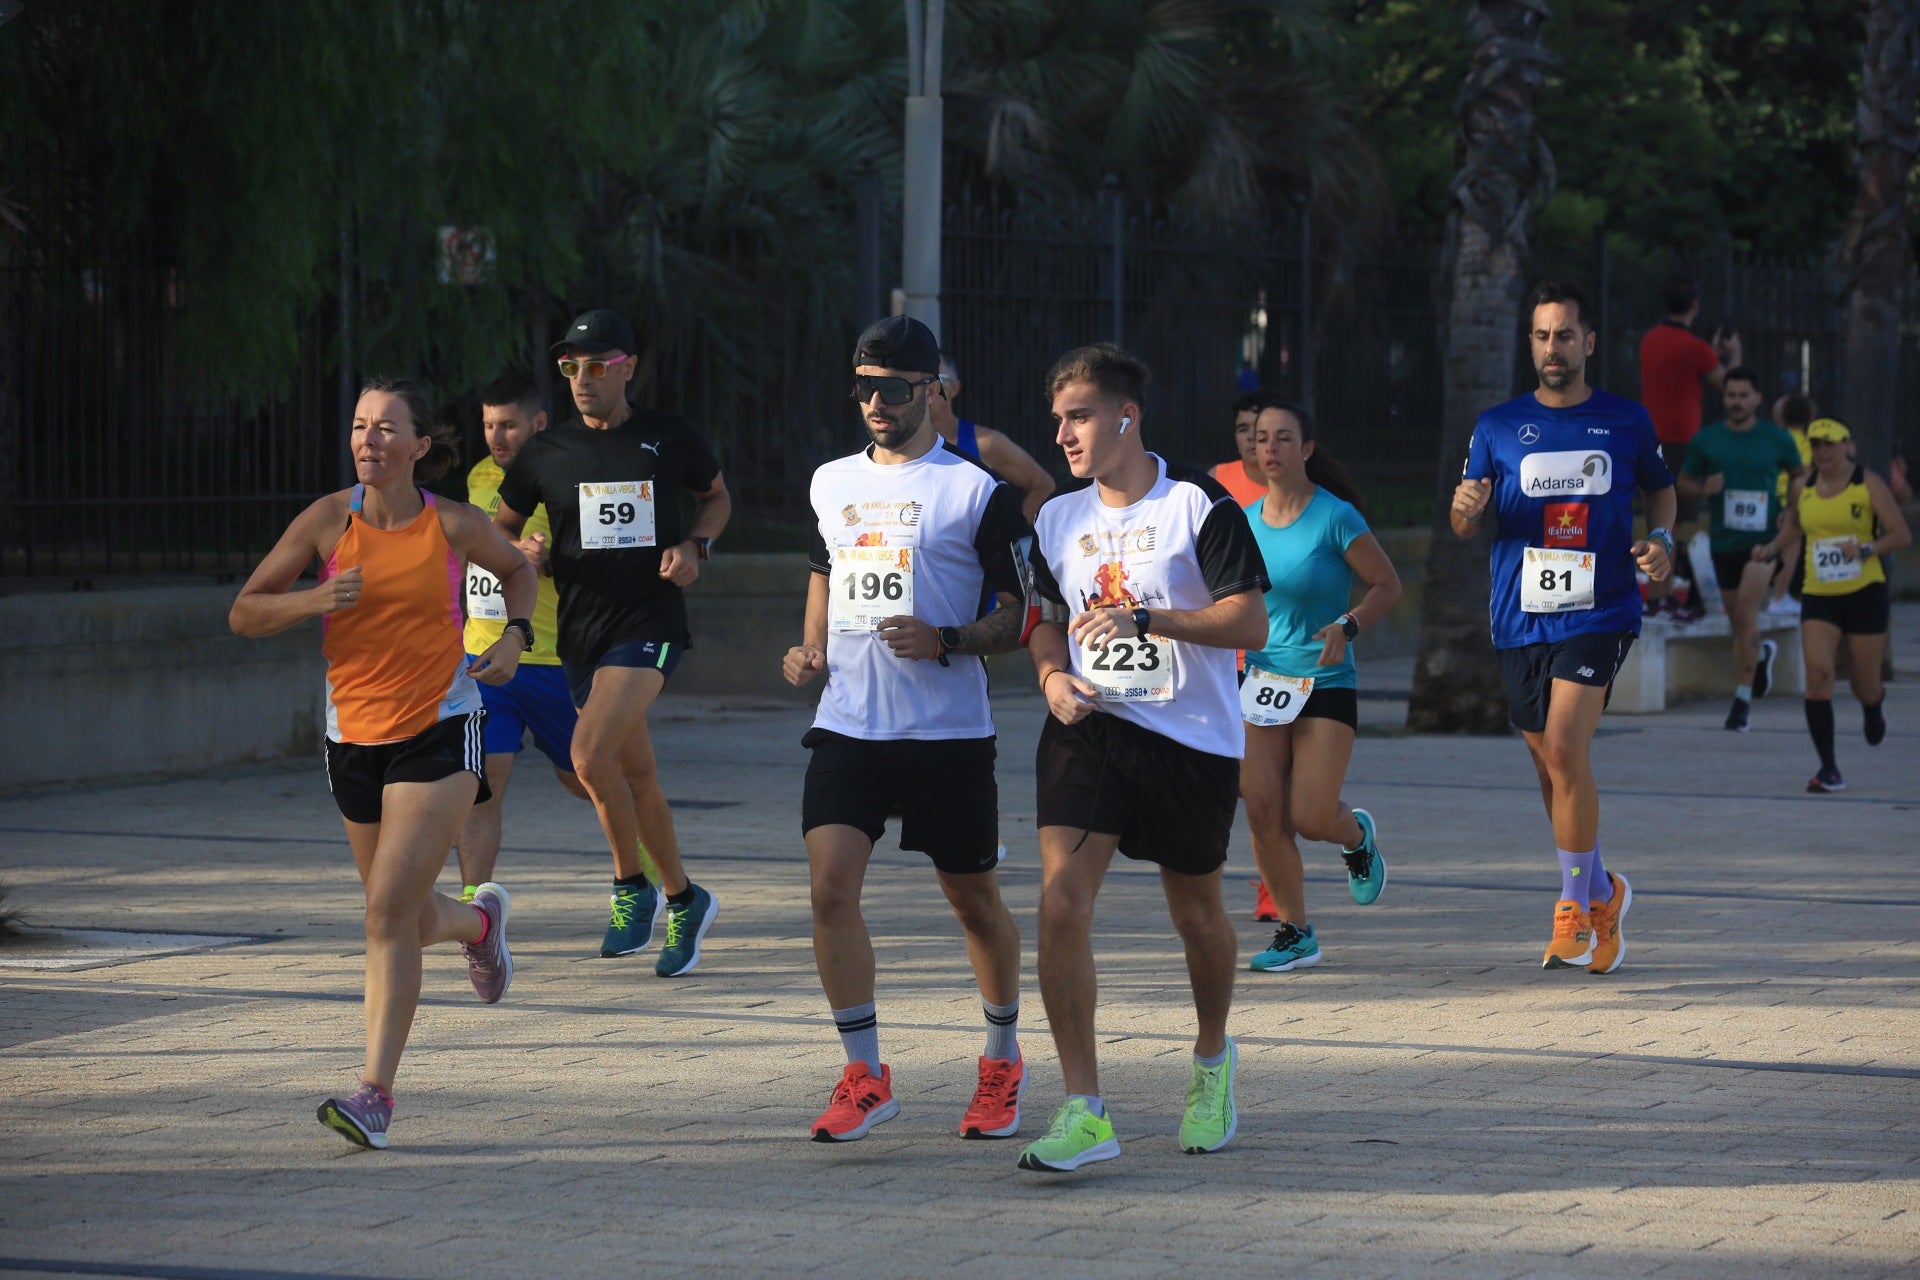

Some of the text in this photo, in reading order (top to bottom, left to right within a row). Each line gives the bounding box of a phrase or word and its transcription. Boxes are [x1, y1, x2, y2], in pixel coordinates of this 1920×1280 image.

[1531, 476, 1585, 491] Adarsa
[599, 503, 635, 525] 59
[1548, 526, 1583, 536] Estrella
[843, 572, 903, 601] 196
[1540, 569, 1572, 591] 81
[1091, 642, 1160, 672] 223
[1124, 687, 1143, 698] asisa
[1255, 686, 1292, 710] 80
